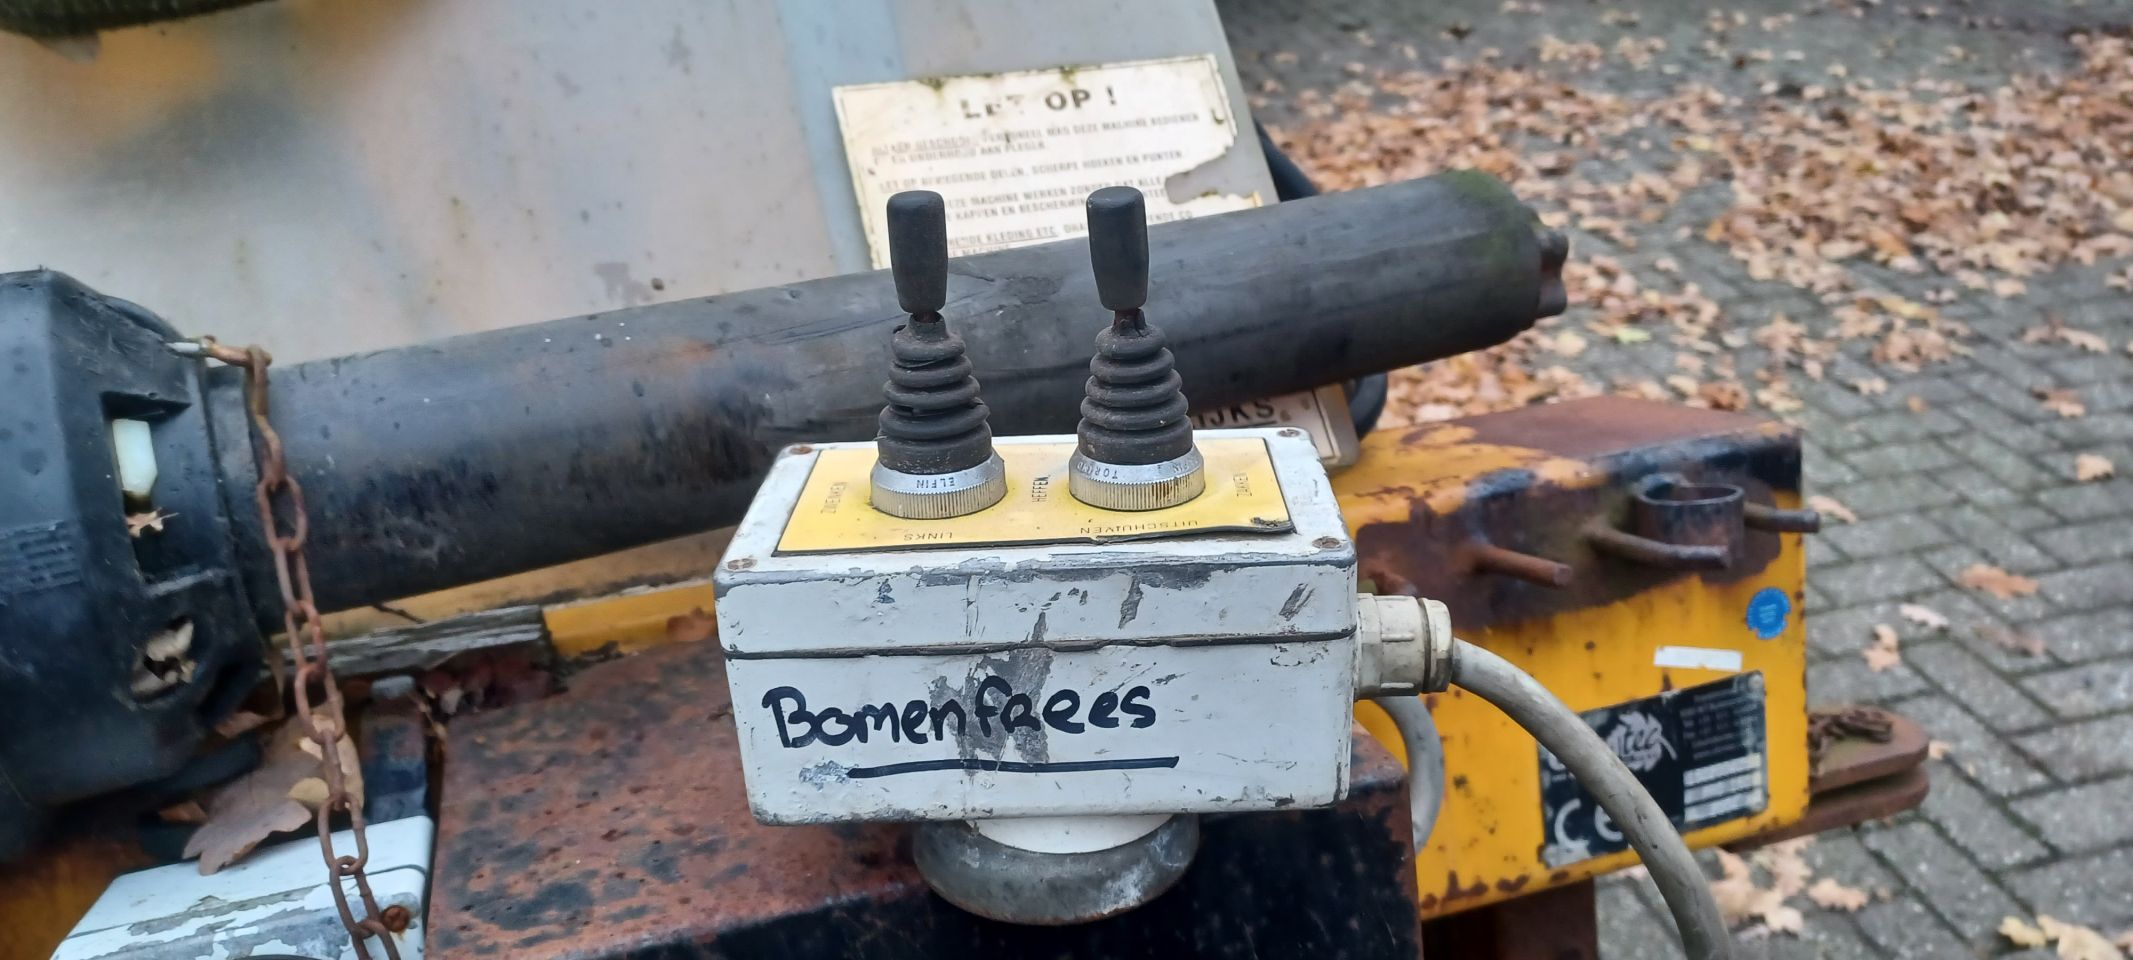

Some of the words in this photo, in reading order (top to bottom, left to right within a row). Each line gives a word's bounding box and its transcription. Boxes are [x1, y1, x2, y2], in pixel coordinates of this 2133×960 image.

[1045, 88, 1091, 110] OP
[1106, 86, 1117, 105] !
[1192, 398, 1275, 428] IJKS
[915, 476, 956, 490] ELFIN
[1031, 476, 1049, 503] HEFFEN
[903, 531, 953, 542] LINKS
[1080, 520, 1198, 535] UITSCHUIVEN
